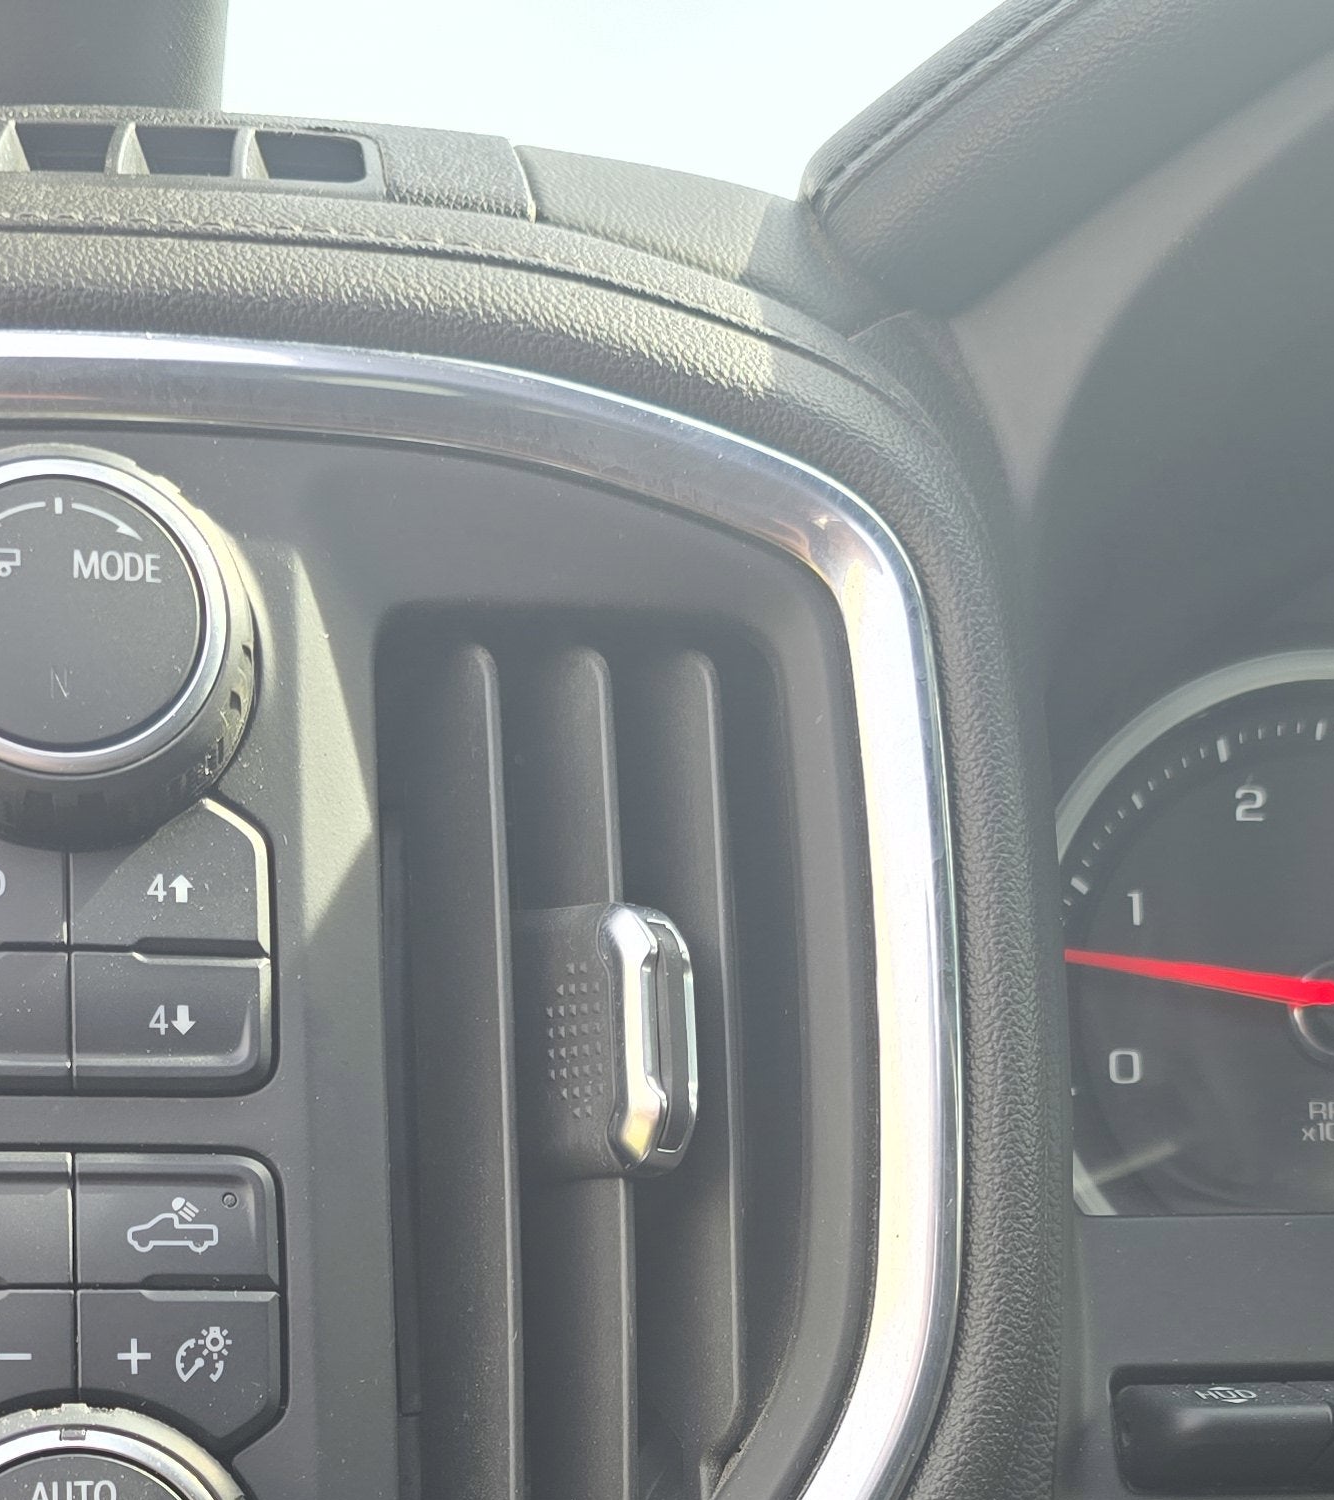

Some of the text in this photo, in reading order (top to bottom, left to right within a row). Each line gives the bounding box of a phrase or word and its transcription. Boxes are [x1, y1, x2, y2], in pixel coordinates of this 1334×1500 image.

[72, 549, 162, 584] MODE
[1234, 786, 1266, 822] 2
[1126, 891, 1143, 926] 1
[1108, 1048, 1142, 1085] 0
